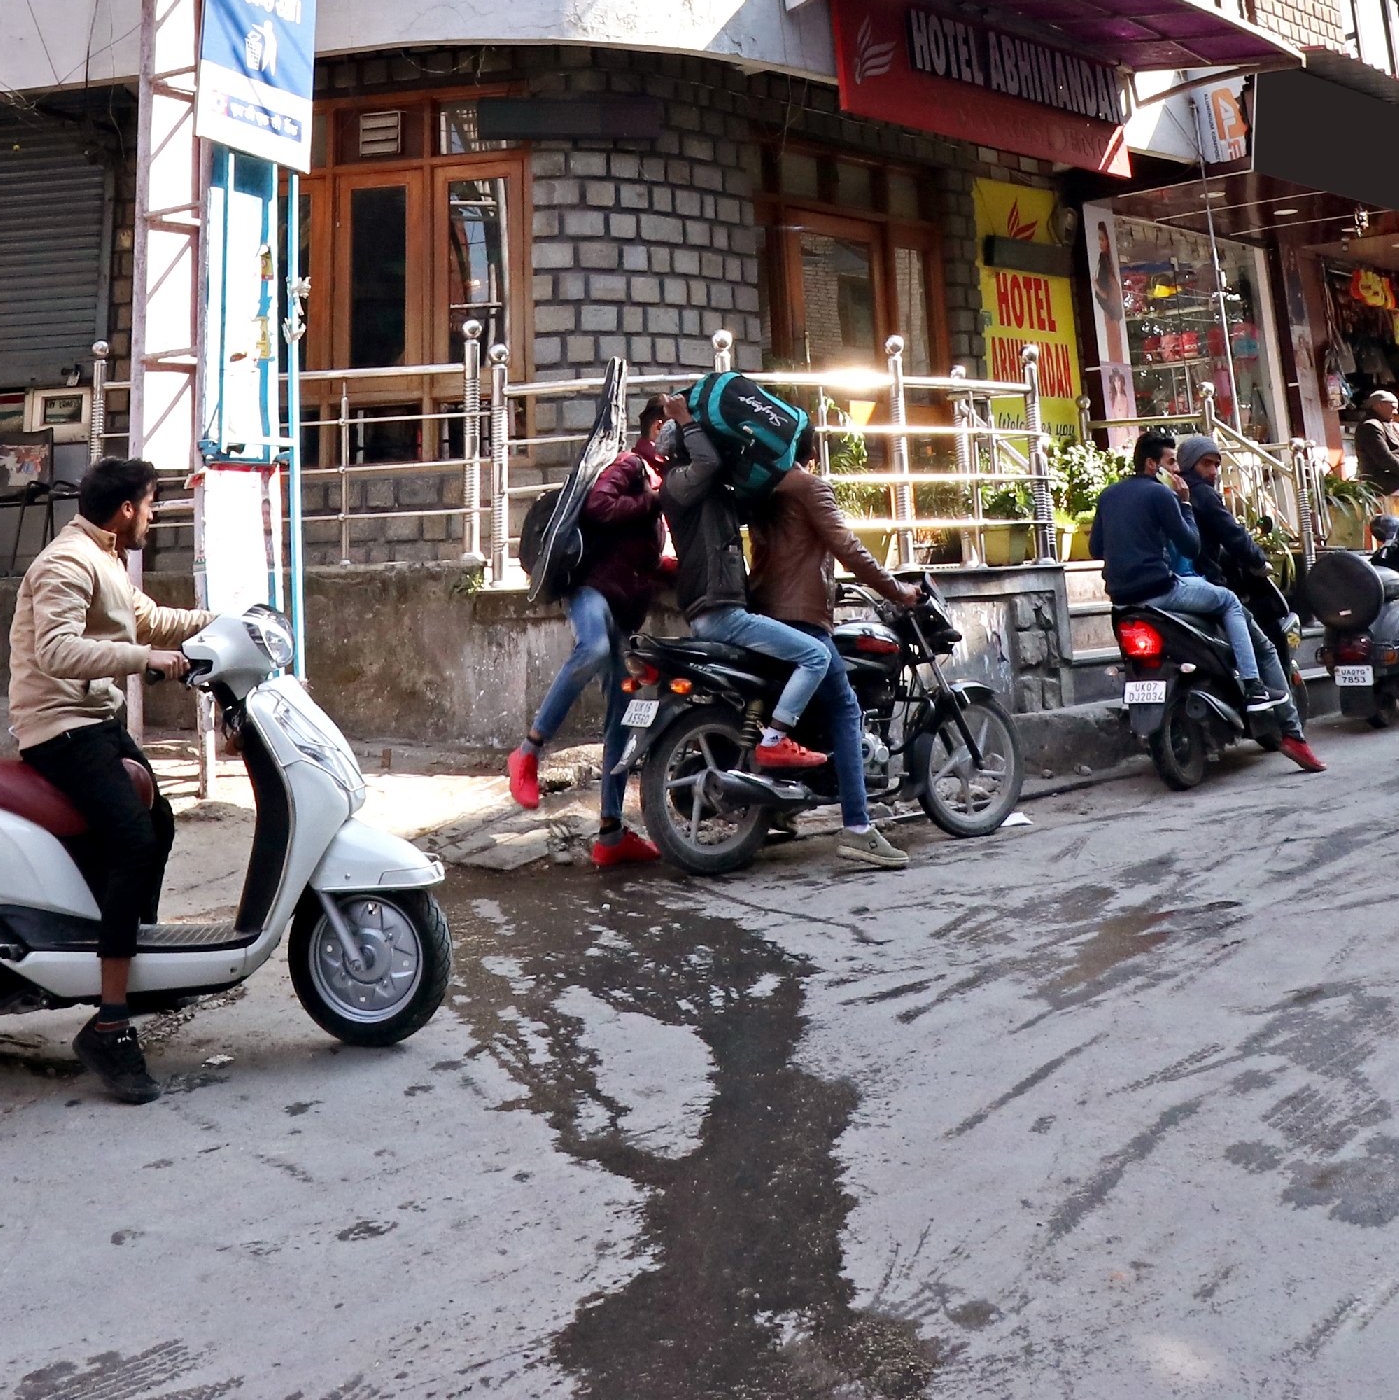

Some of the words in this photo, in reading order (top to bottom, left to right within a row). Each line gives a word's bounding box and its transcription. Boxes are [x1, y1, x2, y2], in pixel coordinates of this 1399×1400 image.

[910, 8, 983, 86] HOTEL
[988, 31, 1124, 126] ABHINANDAN
[995, 272, 1056, 332] HOTEL
[1135, 682, 1158, 692] UK07
